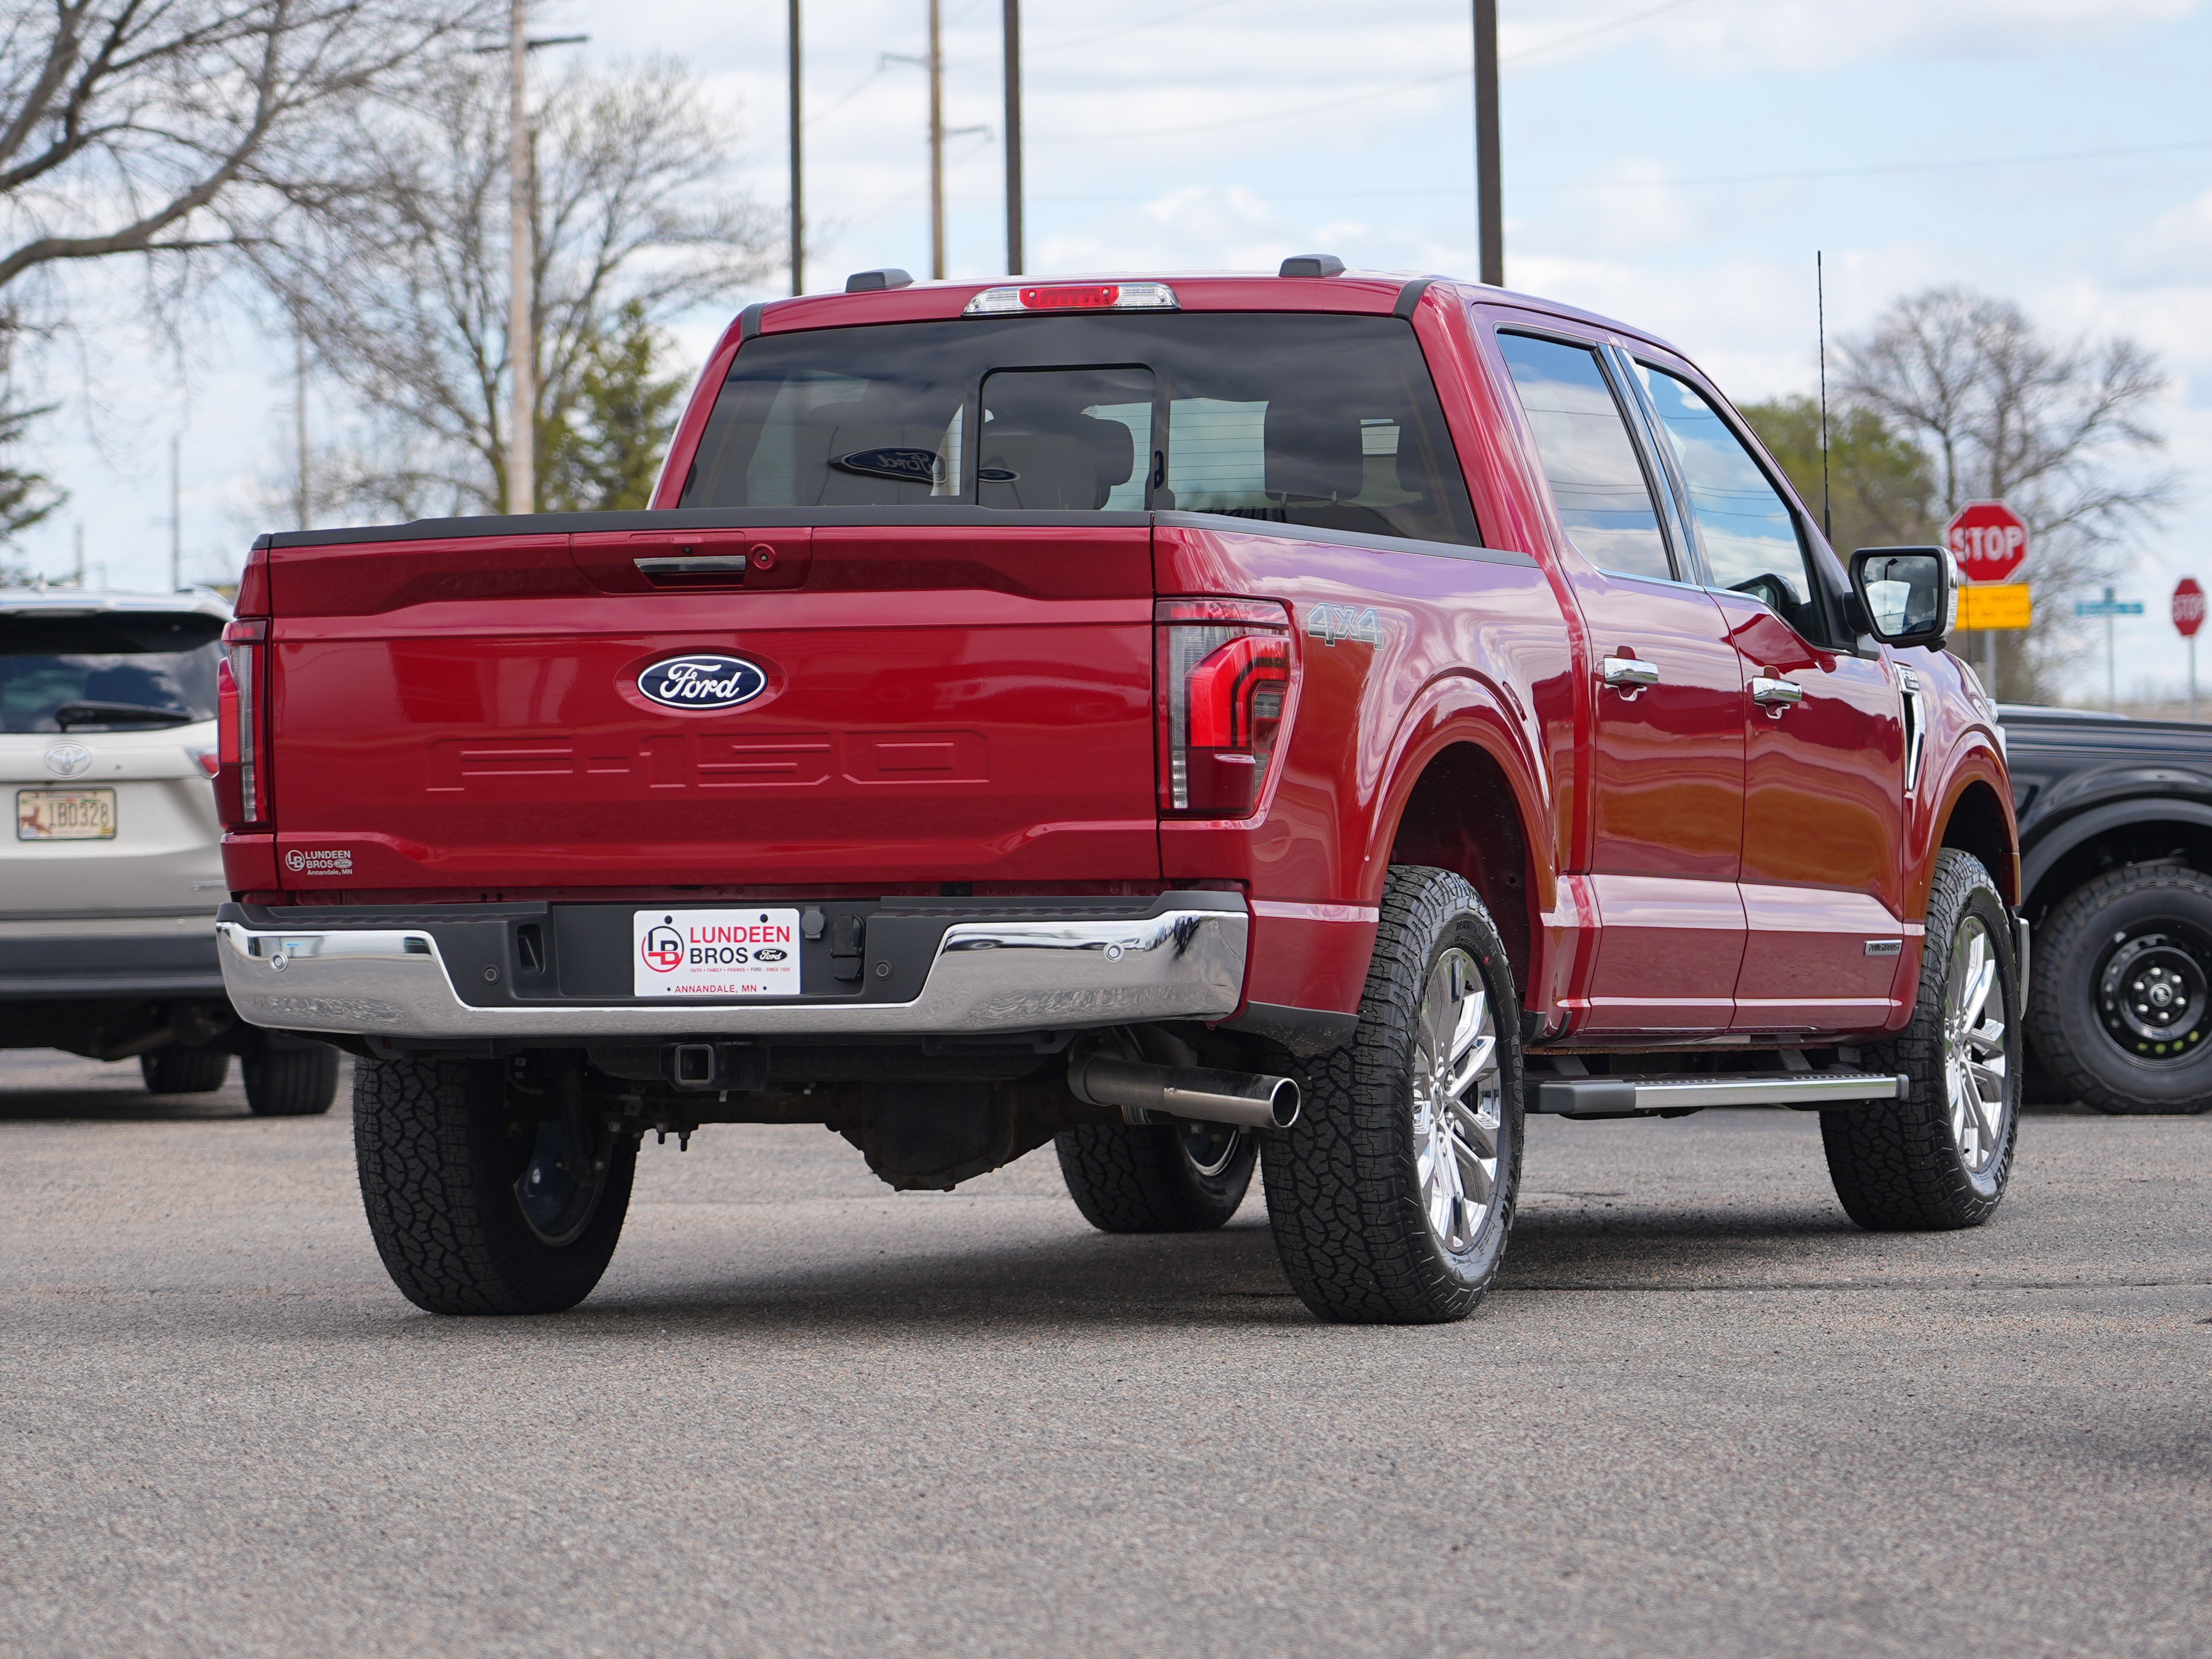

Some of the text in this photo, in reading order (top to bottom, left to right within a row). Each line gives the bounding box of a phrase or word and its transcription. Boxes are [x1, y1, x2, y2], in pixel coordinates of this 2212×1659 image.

[1950, 525, 2024, 561] STOP
[2173, 593, 2204, 622] STOP
[659, 663, 742, 698] Ford
[305, 850, 351, 859] LUNDEEN
[306, 860, 334, 869] BROS
[690, 926, 790, 943] LUNDEEN
[690, 947, 748, 964] BROS
[759, 949, 782, 960] Ford
[675, 985, 738, 994] ANNANDALE,
